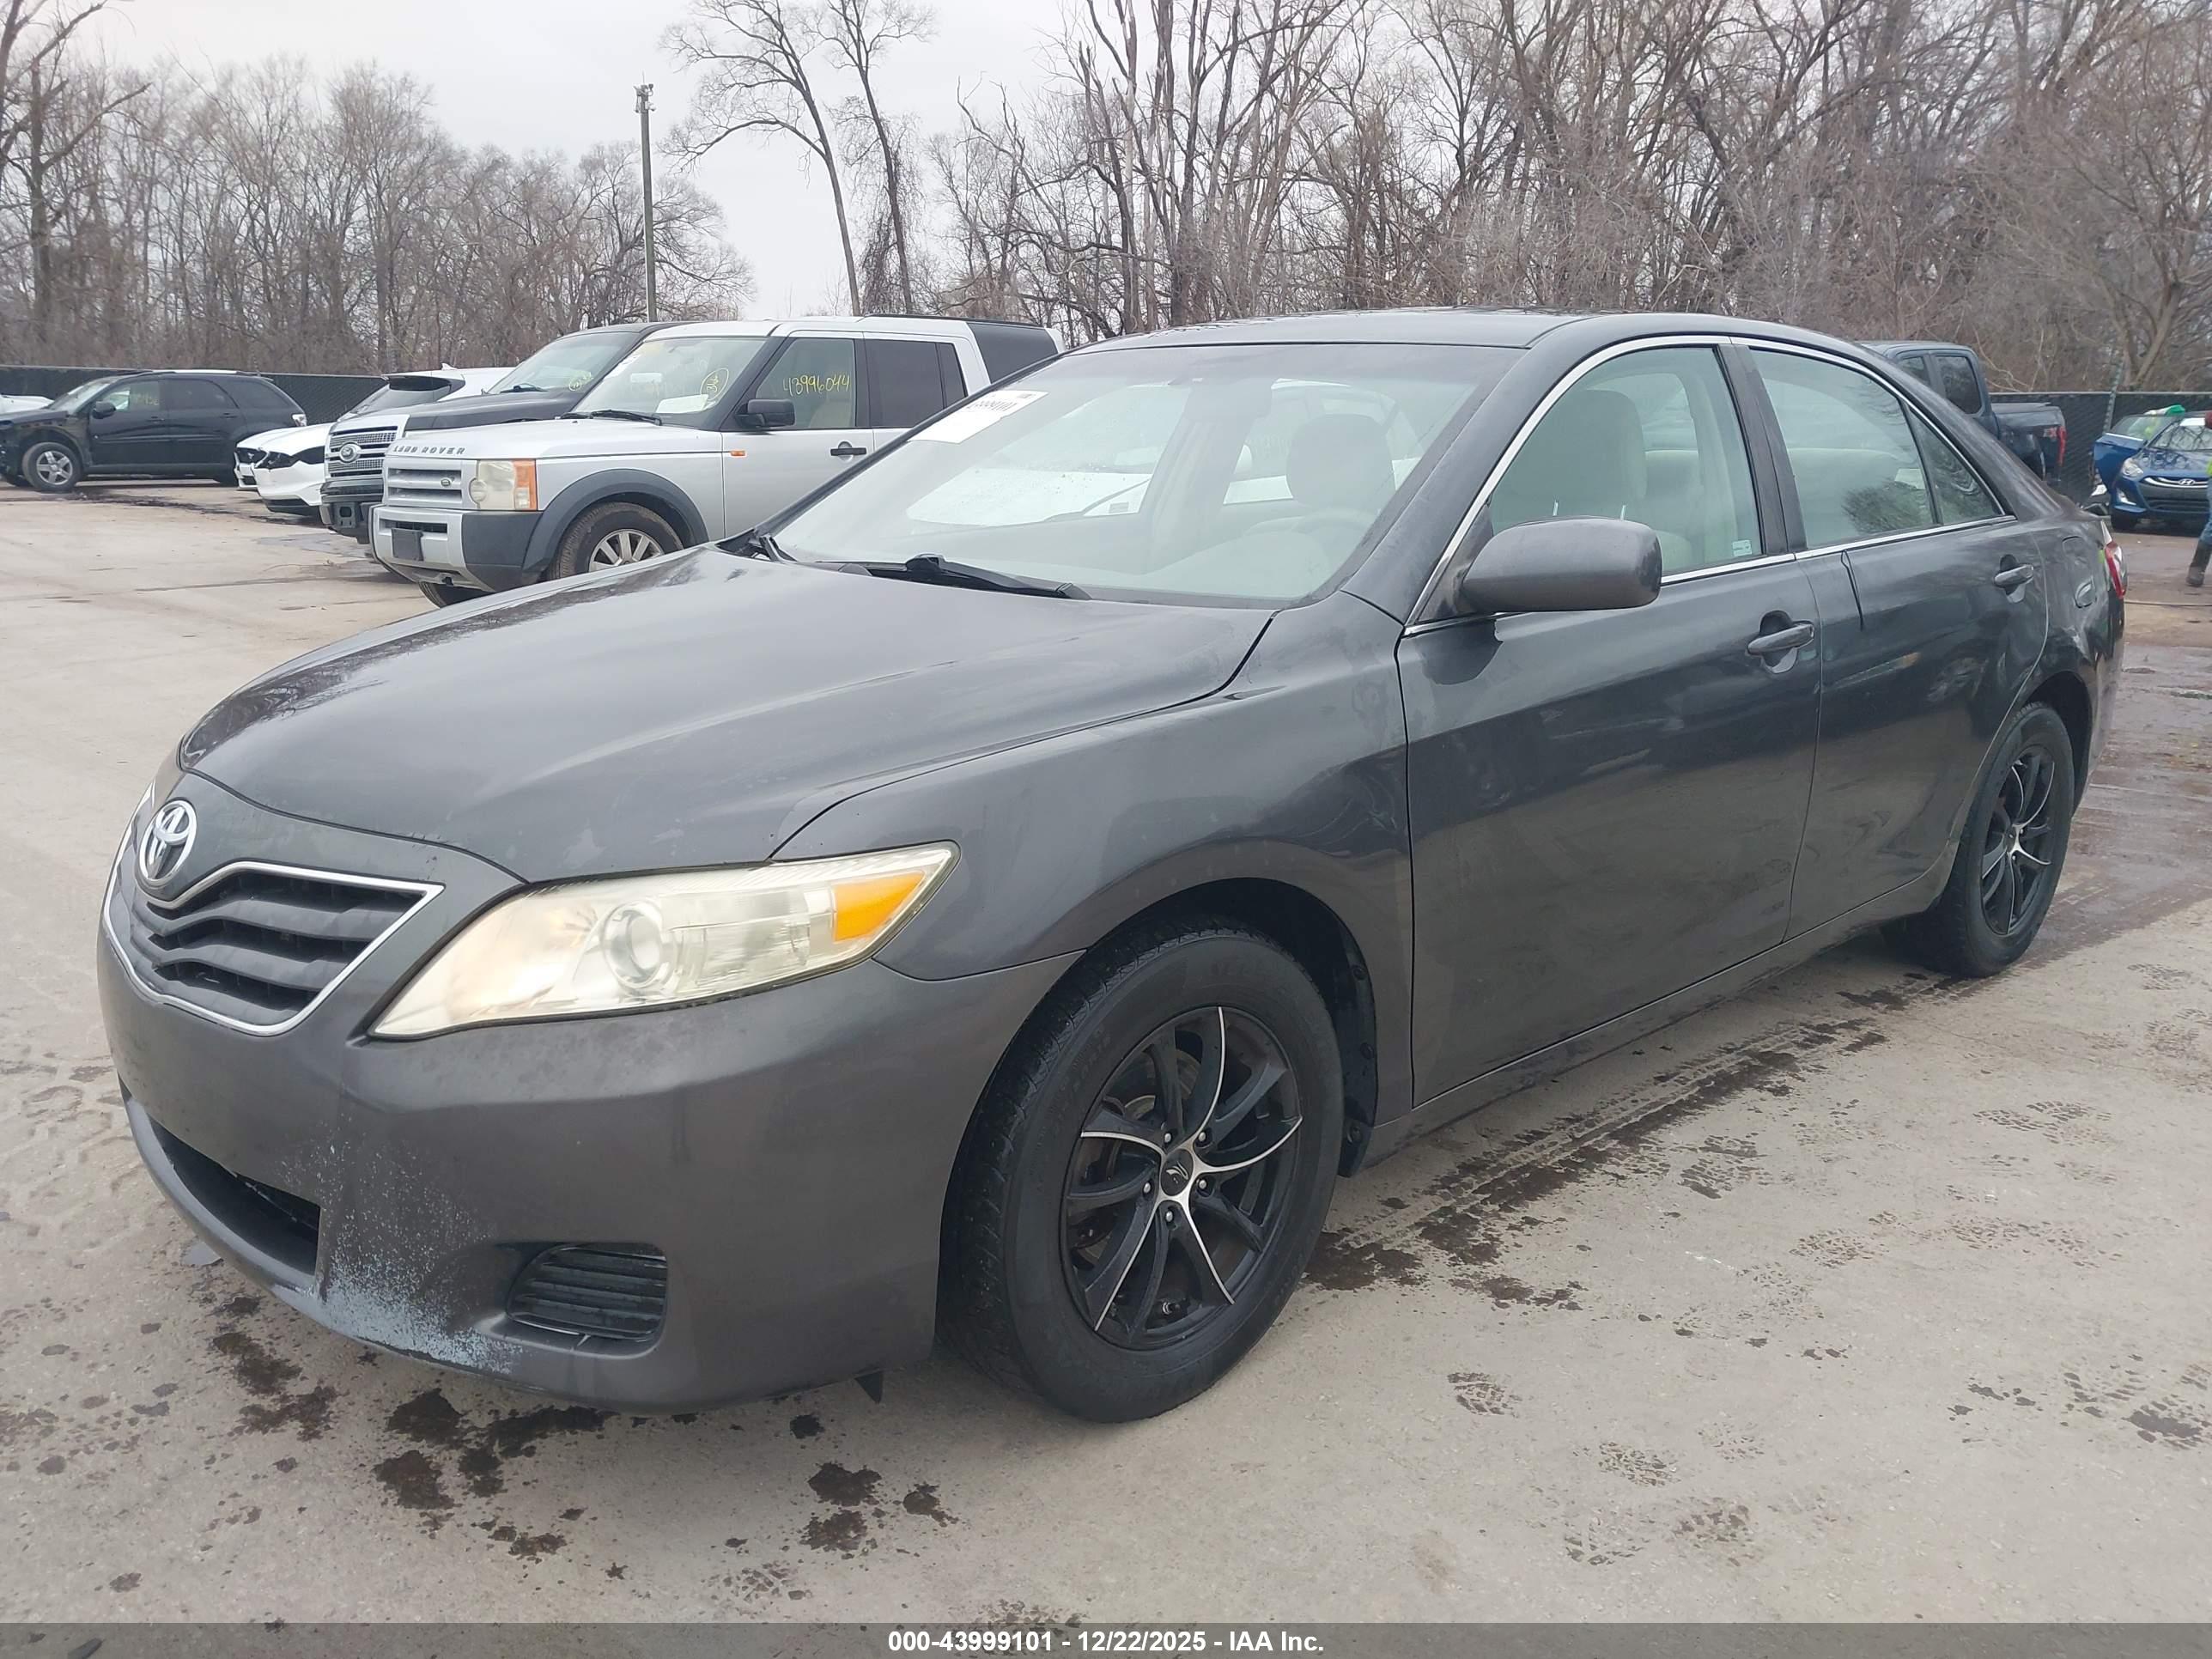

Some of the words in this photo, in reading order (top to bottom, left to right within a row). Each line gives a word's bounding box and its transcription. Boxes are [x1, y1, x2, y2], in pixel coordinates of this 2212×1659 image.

[782, 374, 850, 397] 43996044
[392, 445, 418, 453] LAND
[421, 446, 465, 455] ROVER
